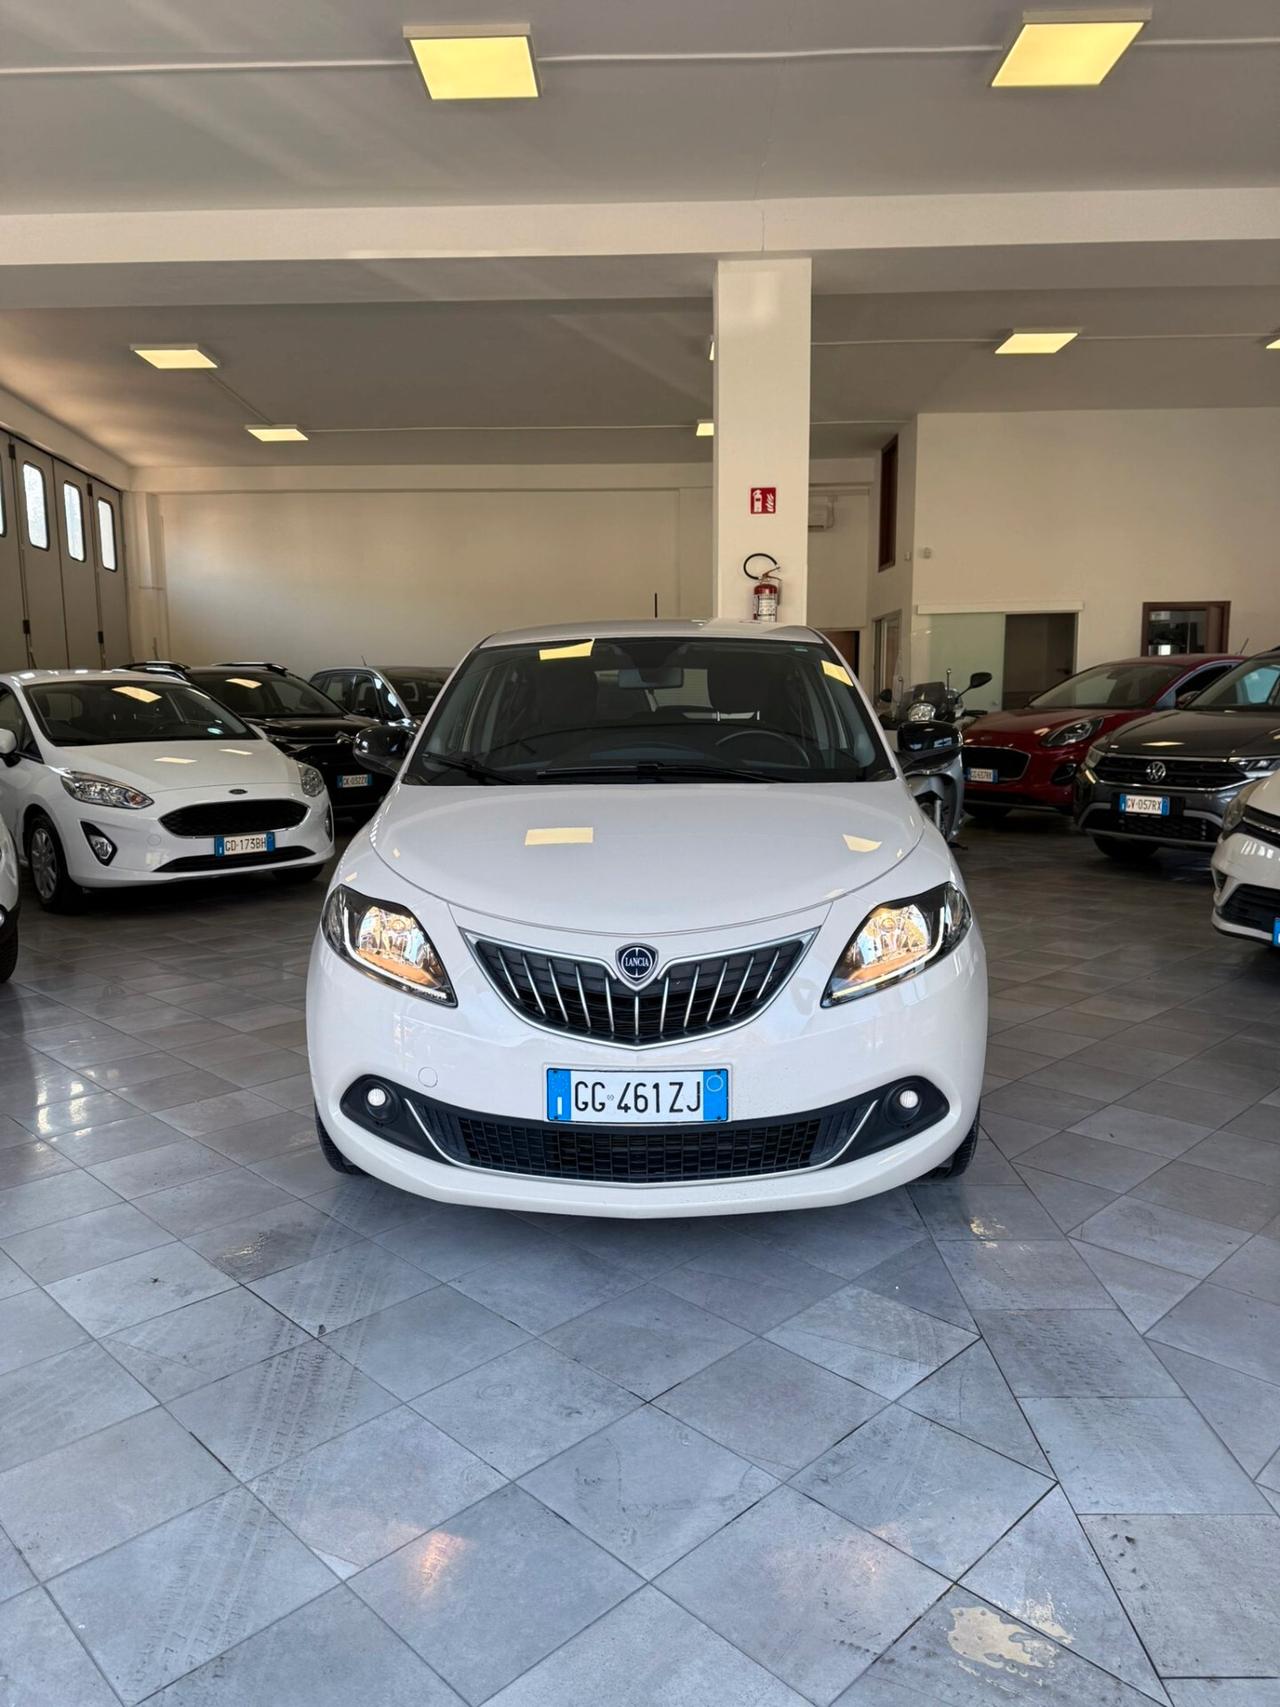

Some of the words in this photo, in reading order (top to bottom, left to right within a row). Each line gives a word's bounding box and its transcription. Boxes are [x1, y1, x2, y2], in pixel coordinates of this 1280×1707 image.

[1137, 799, 1162, 811] 057RX
[239, 837, 266, 851] 173BH
[625, 957, 649, 967] LANCIA
[574, 1081, 606, 1112] GG
[617, 1081, 701, 1113] 461ZJ
